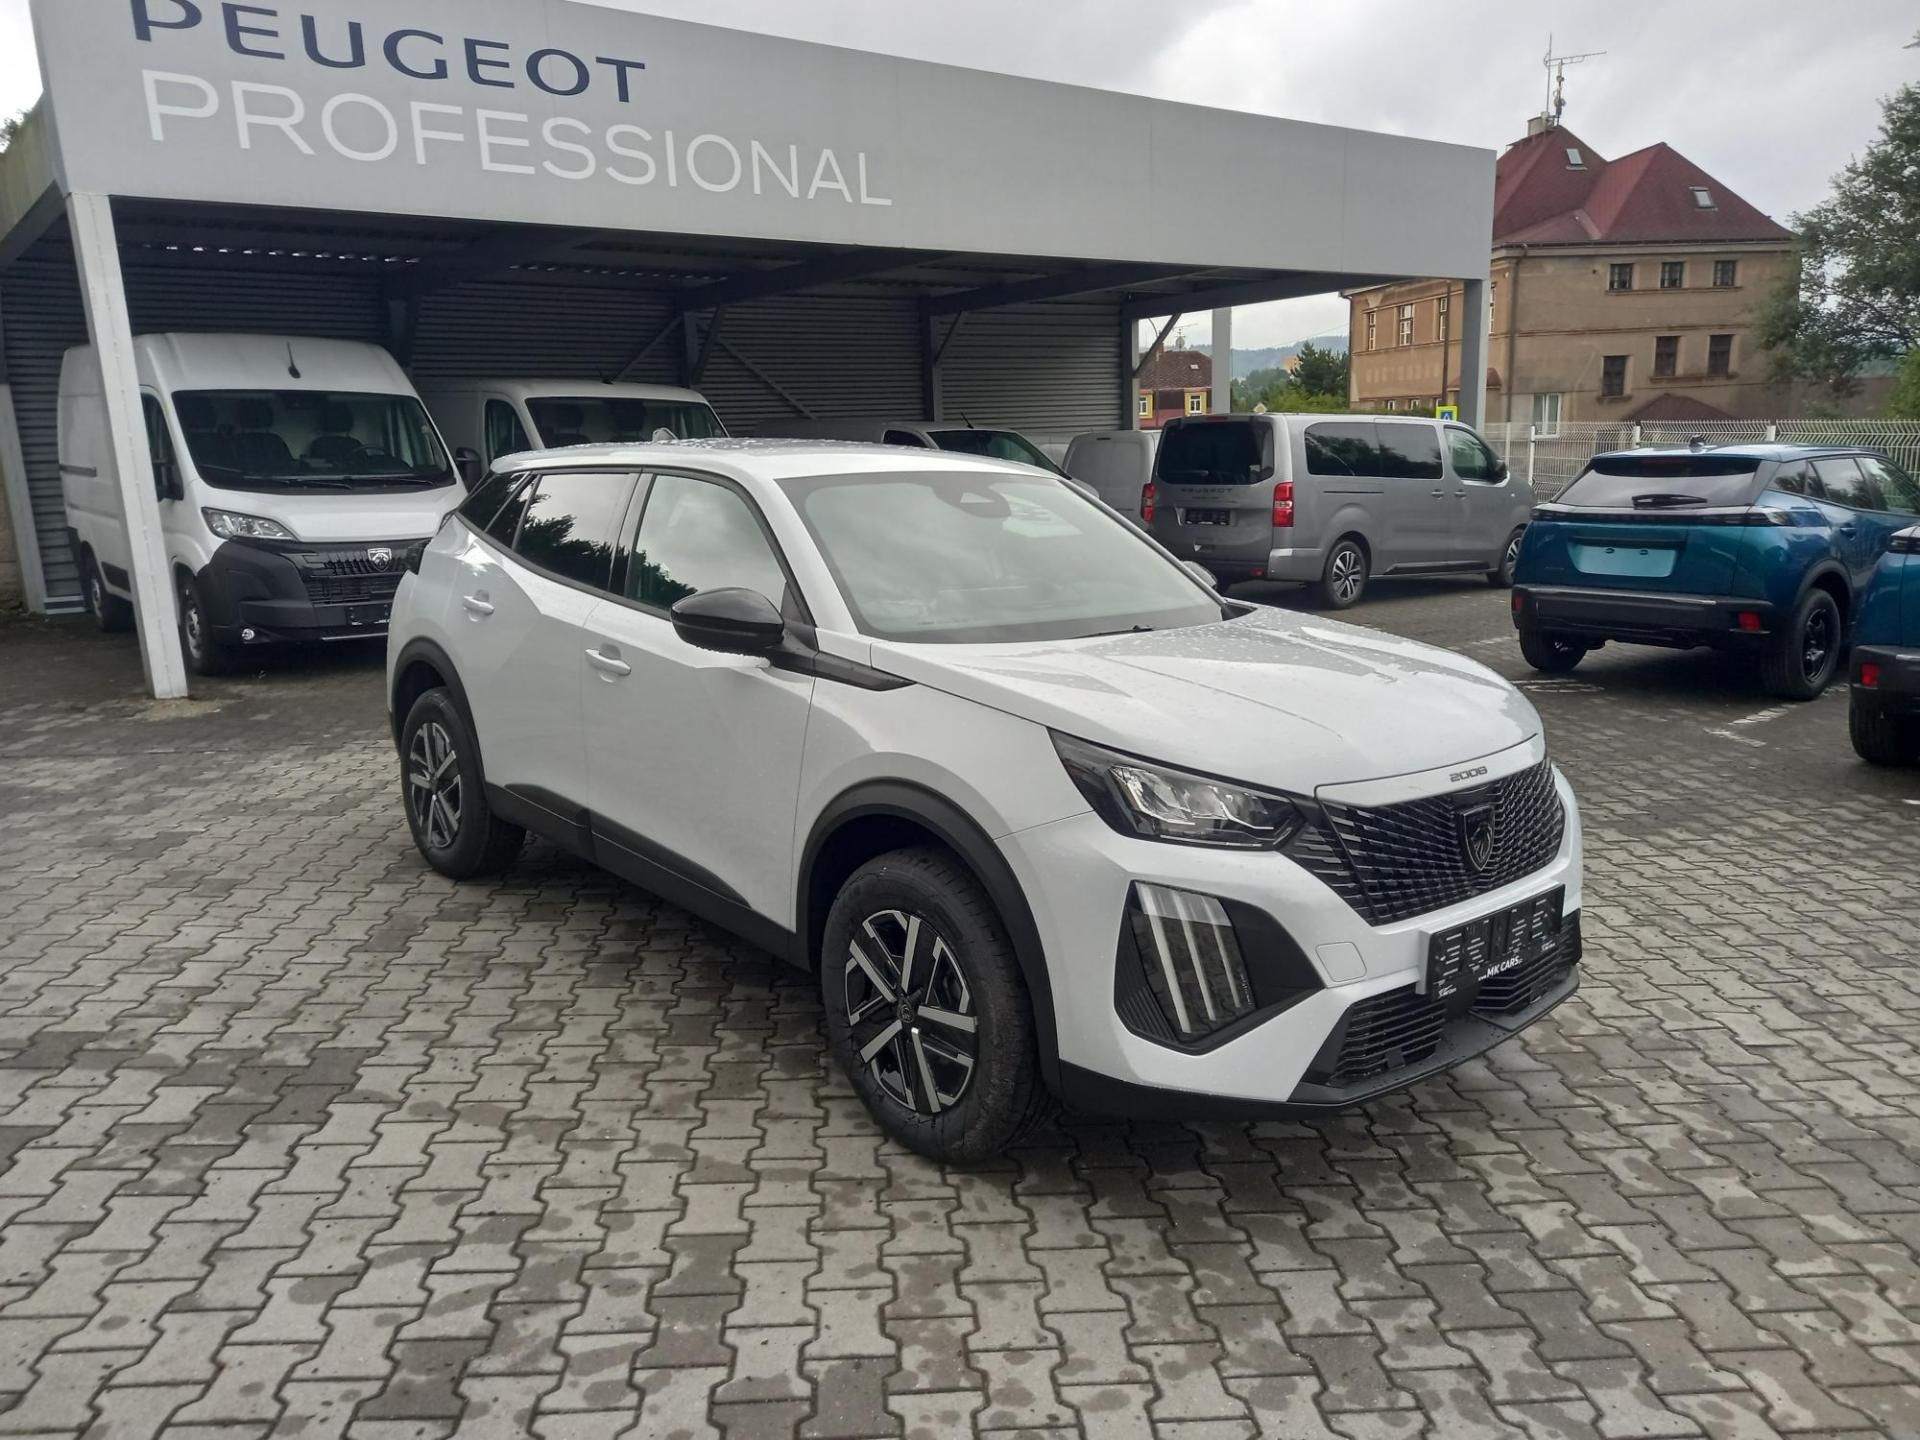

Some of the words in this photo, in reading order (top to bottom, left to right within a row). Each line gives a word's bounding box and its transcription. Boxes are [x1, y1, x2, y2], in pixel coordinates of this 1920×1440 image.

[130, 0, 646, 103] PEUGEOT
[141, 69, 893, 206] PROFESSIONAL
[1449, 766, 1488, 782] 2008
